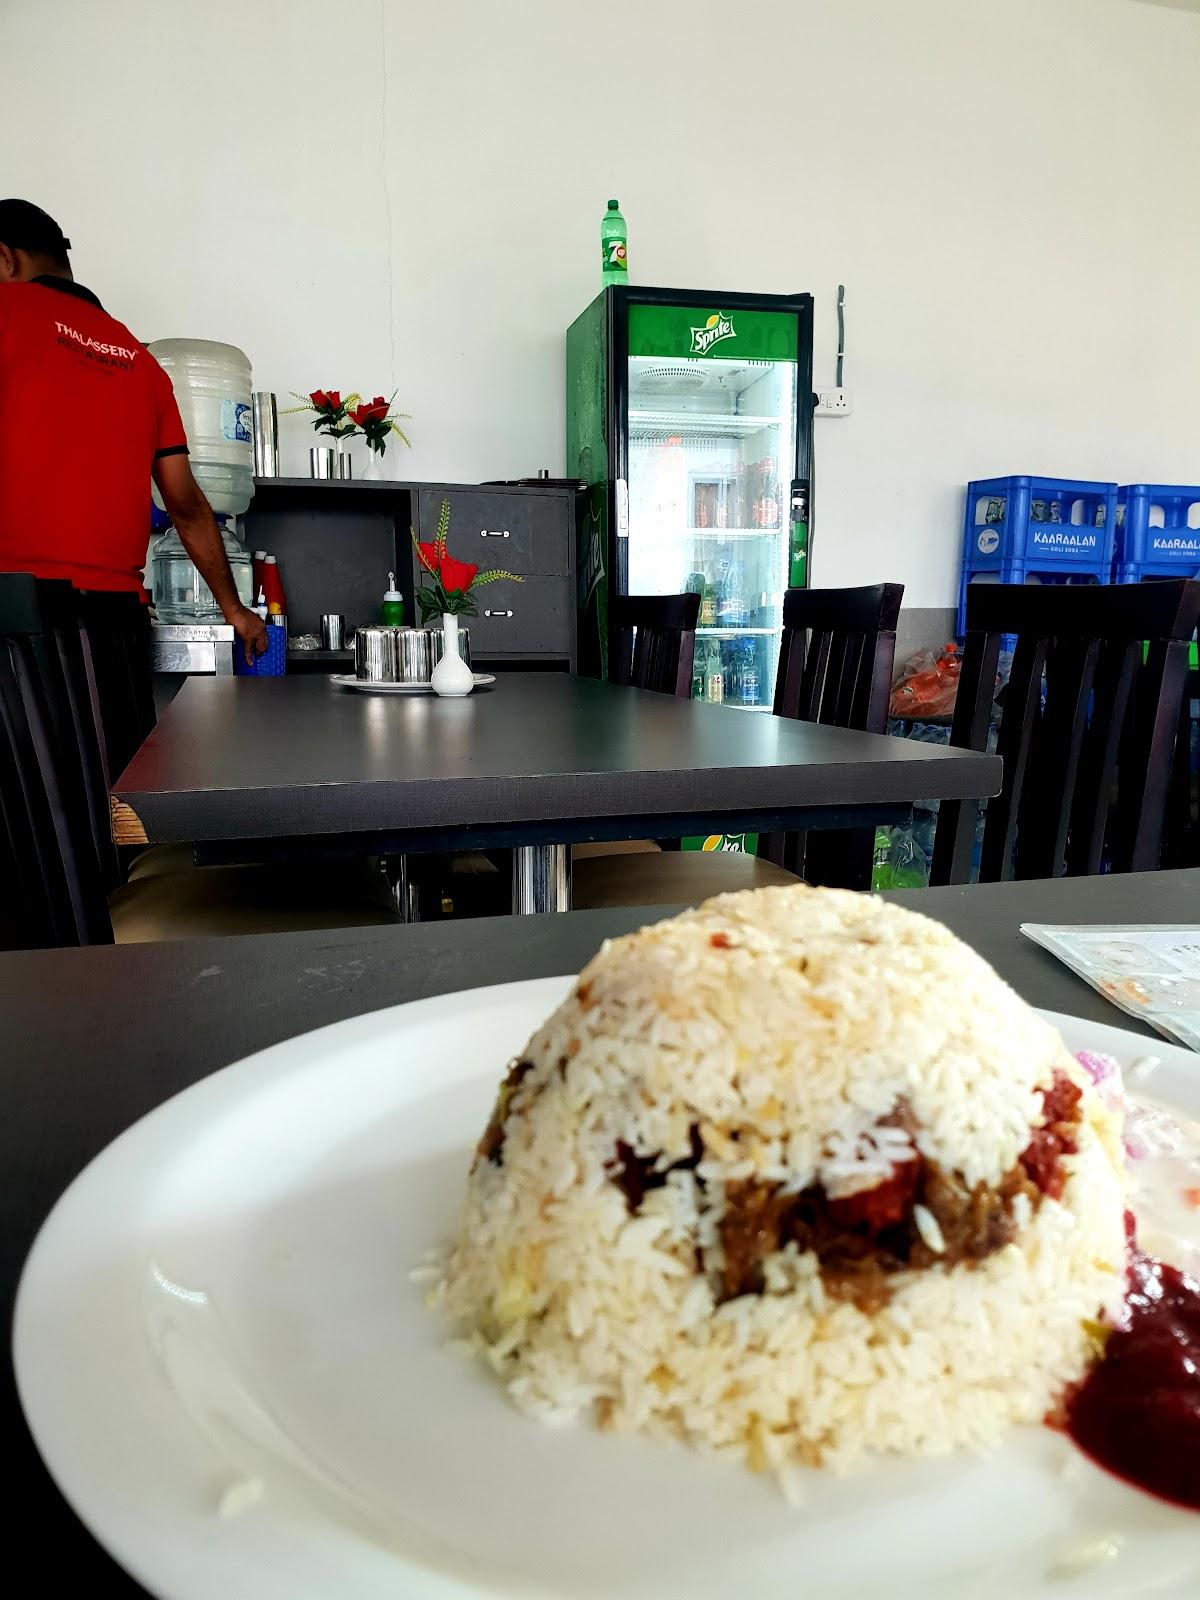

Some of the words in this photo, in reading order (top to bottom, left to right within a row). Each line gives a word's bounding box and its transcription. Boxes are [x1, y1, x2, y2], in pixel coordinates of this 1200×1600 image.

[55, 321, 136, 360] THALASSERY
[695, 318, 731, 351] Sprite
[1034, 532, 1096, 547] KAARAALAN
[1153, 538, 1200, 549] KAARAAL
